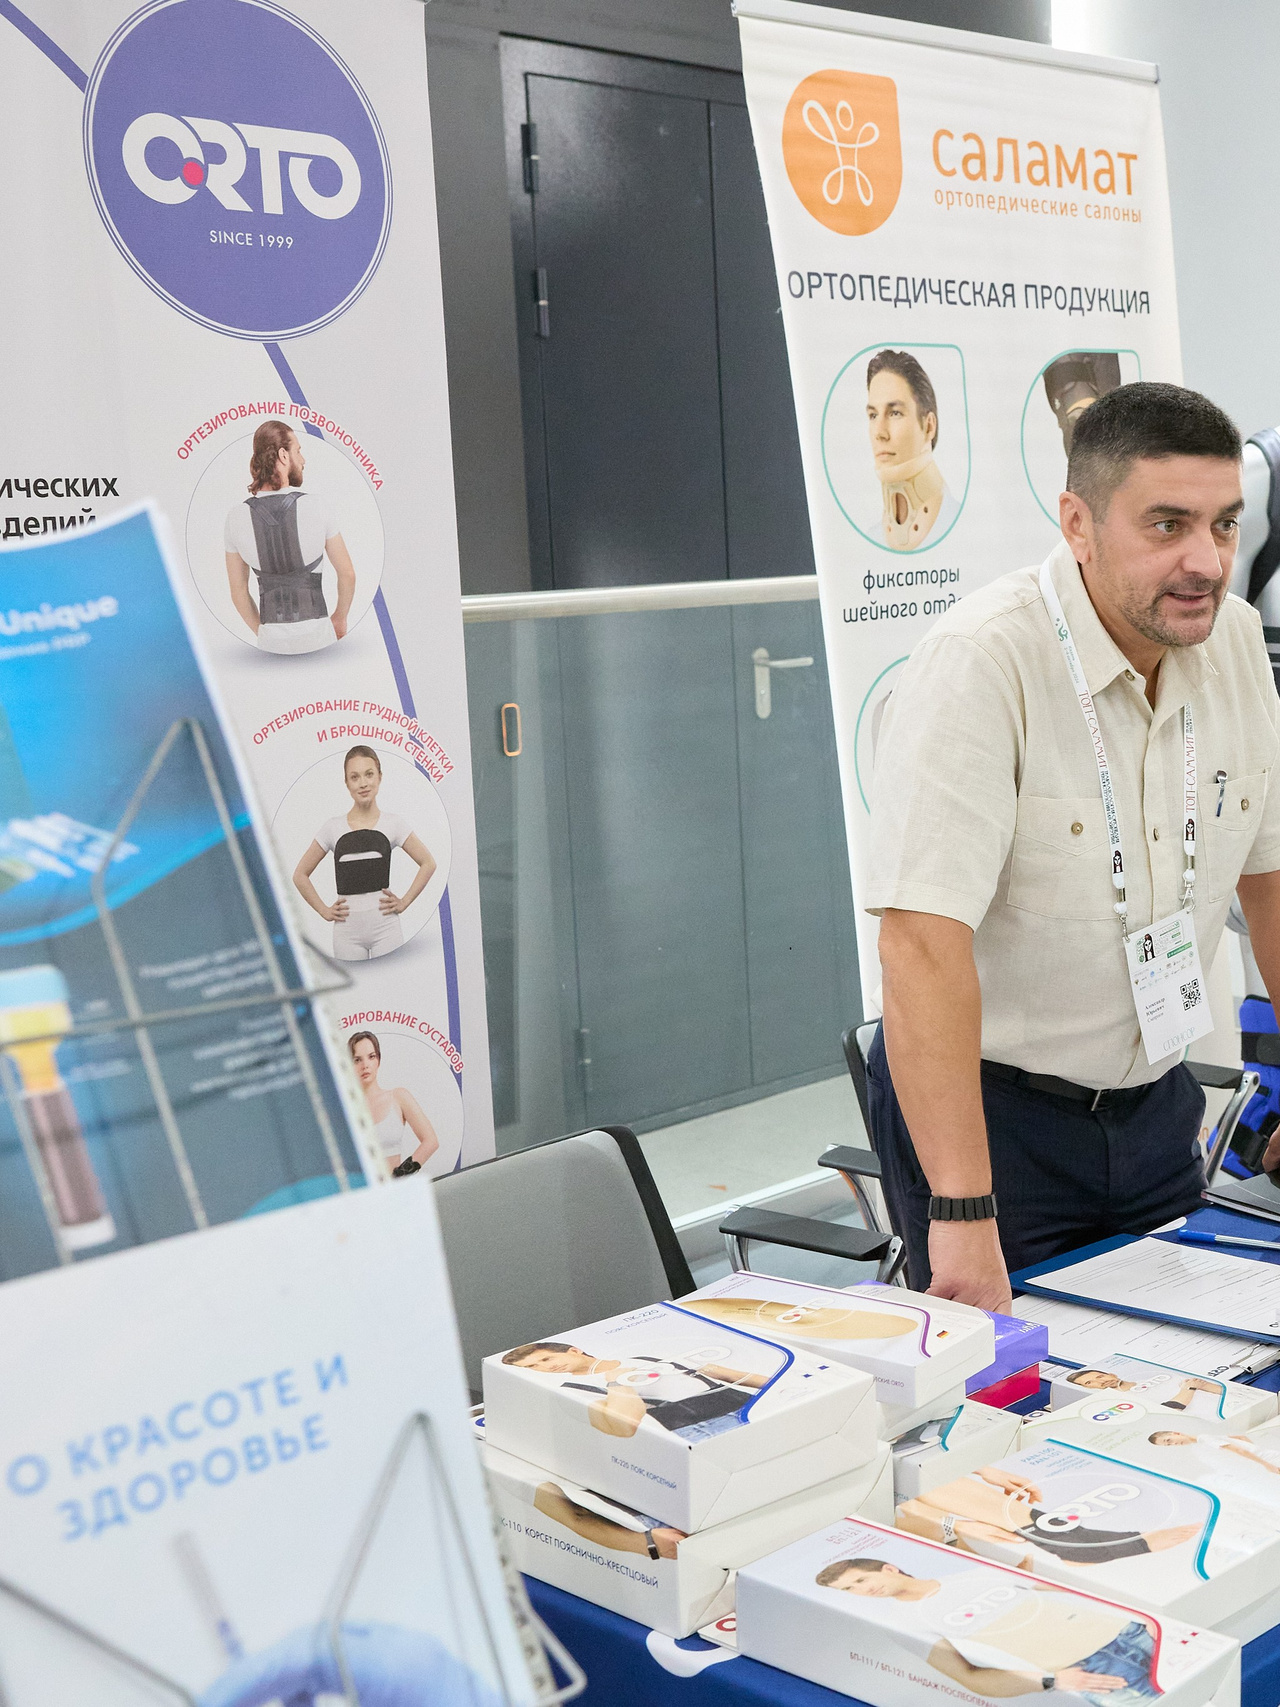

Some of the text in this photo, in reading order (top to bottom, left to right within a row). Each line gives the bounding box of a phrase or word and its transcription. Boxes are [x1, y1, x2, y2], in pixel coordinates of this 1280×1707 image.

[122, 112, 362, 220] ORTO
[931, 128, 1138, 196] саламат
[934, 188, 1142, 224] ортопедические салоны
[209, 229, 294, 250] SINCE 1999
[787, 270, 1151, 318] ОРТОПЕДИЧЕСКАЯ ПРОДУКЦИЯ
[177, 401, 384, 491] ОРТЕЗИРОВАНИЕ ПОЗВОНОЧНИКА
[843, 593, 963, 623] шейного отд
[863, 568, 960, 595] фиксаторы
[253, 699, 455, 774] ОРТЕЗИРОВАНИЕ ГРУДНОЙ КЛЕТКИ
[316, 724, 446, 783] И БРЮШНОЙ СТЕНКИ
[1078, 690, 1108, 768] ТОП-САММИТ
[1186, 735, 1195, 813] ТОП-САММИТ
[339, 1010, 465, 1073] ЗИРОВАНИЕ СУСТАВОВ
[1163, 1027, 1195, 1051] СПОНСОР
[5, 1353, 351, 1497] О КРАСОТЕ И
[55, 1412, 332, 1543] ЗДОРОВЬЕ
[630, 1464, 646, 1477] ПОЯС
[646, 1471, 677, 1490] КОРСЕТНЫЙ
[1036, 1483, 1140, 1532] ORTO
[524, 1527, 552, 1545] КОРСЕТ
[554, 1538, 659, 1589] ПОЯСНИЧНО-КРЕСТЦОВЫЙ
[908, 1673, 939, 1690] БАНДАЖ
